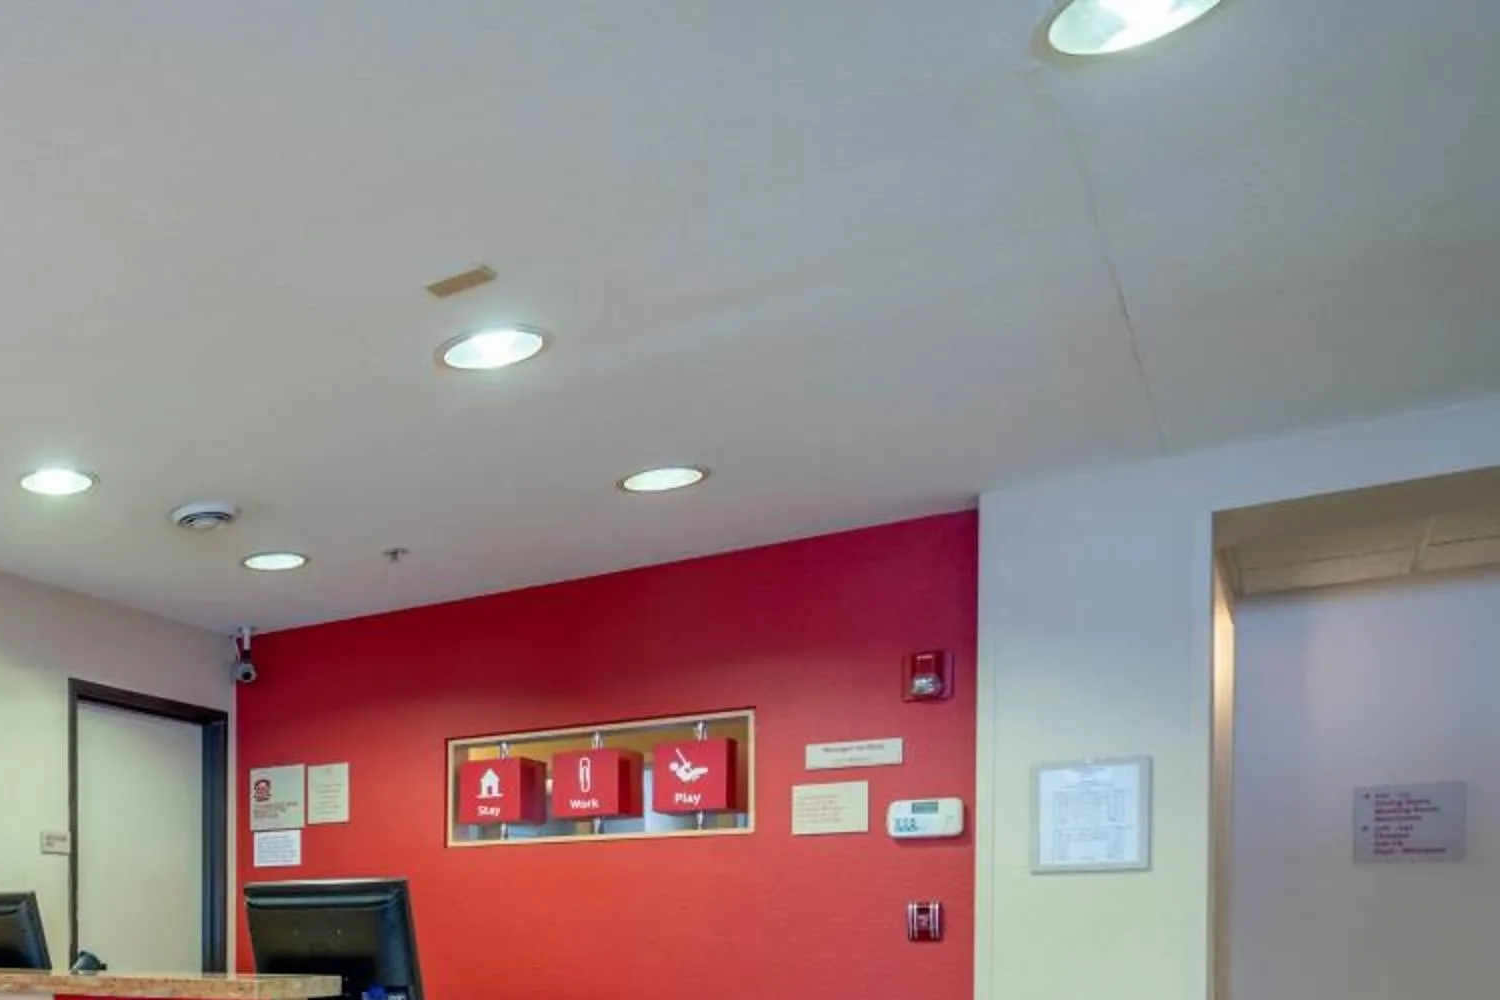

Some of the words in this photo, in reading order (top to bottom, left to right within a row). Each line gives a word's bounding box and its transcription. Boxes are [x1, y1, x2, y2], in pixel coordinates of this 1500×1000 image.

[569, 798, 599, 811] Work
[674, 792, 702, 806] Play
[476, 804, 501, 817] Stay
